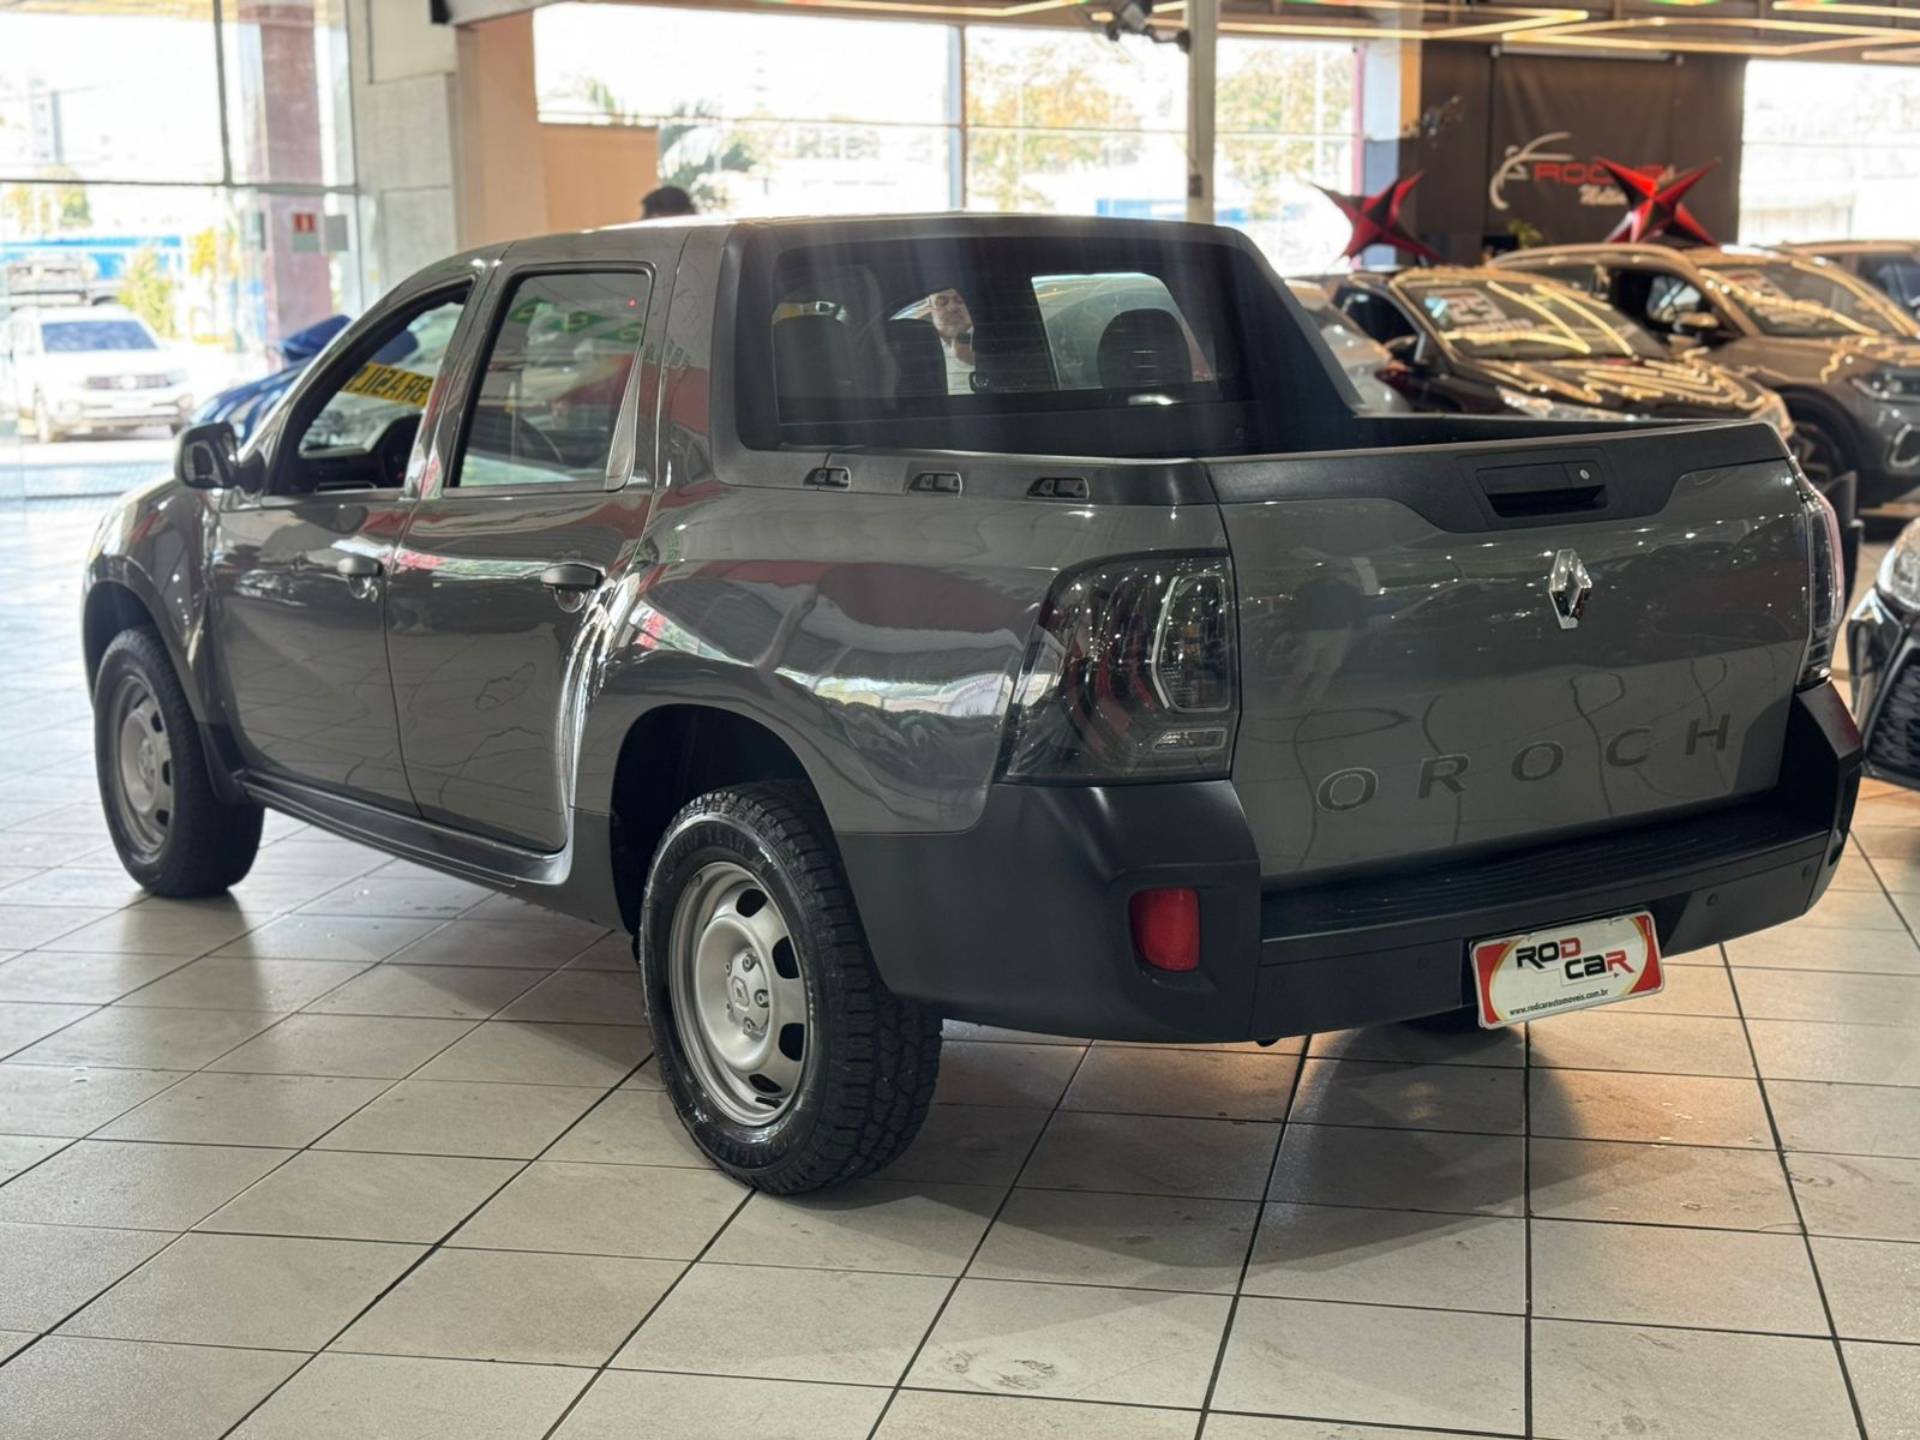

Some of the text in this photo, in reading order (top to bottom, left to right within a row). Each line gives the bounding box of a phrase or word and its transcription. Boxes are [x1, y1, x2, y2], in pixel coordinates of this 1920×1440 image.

[1317, 716, 1730, 812] OROCH
[1516, 937, 1583, 970] ROD
[1509, 988, 1609, 1016] www.rodcarautomoveis.com.br
